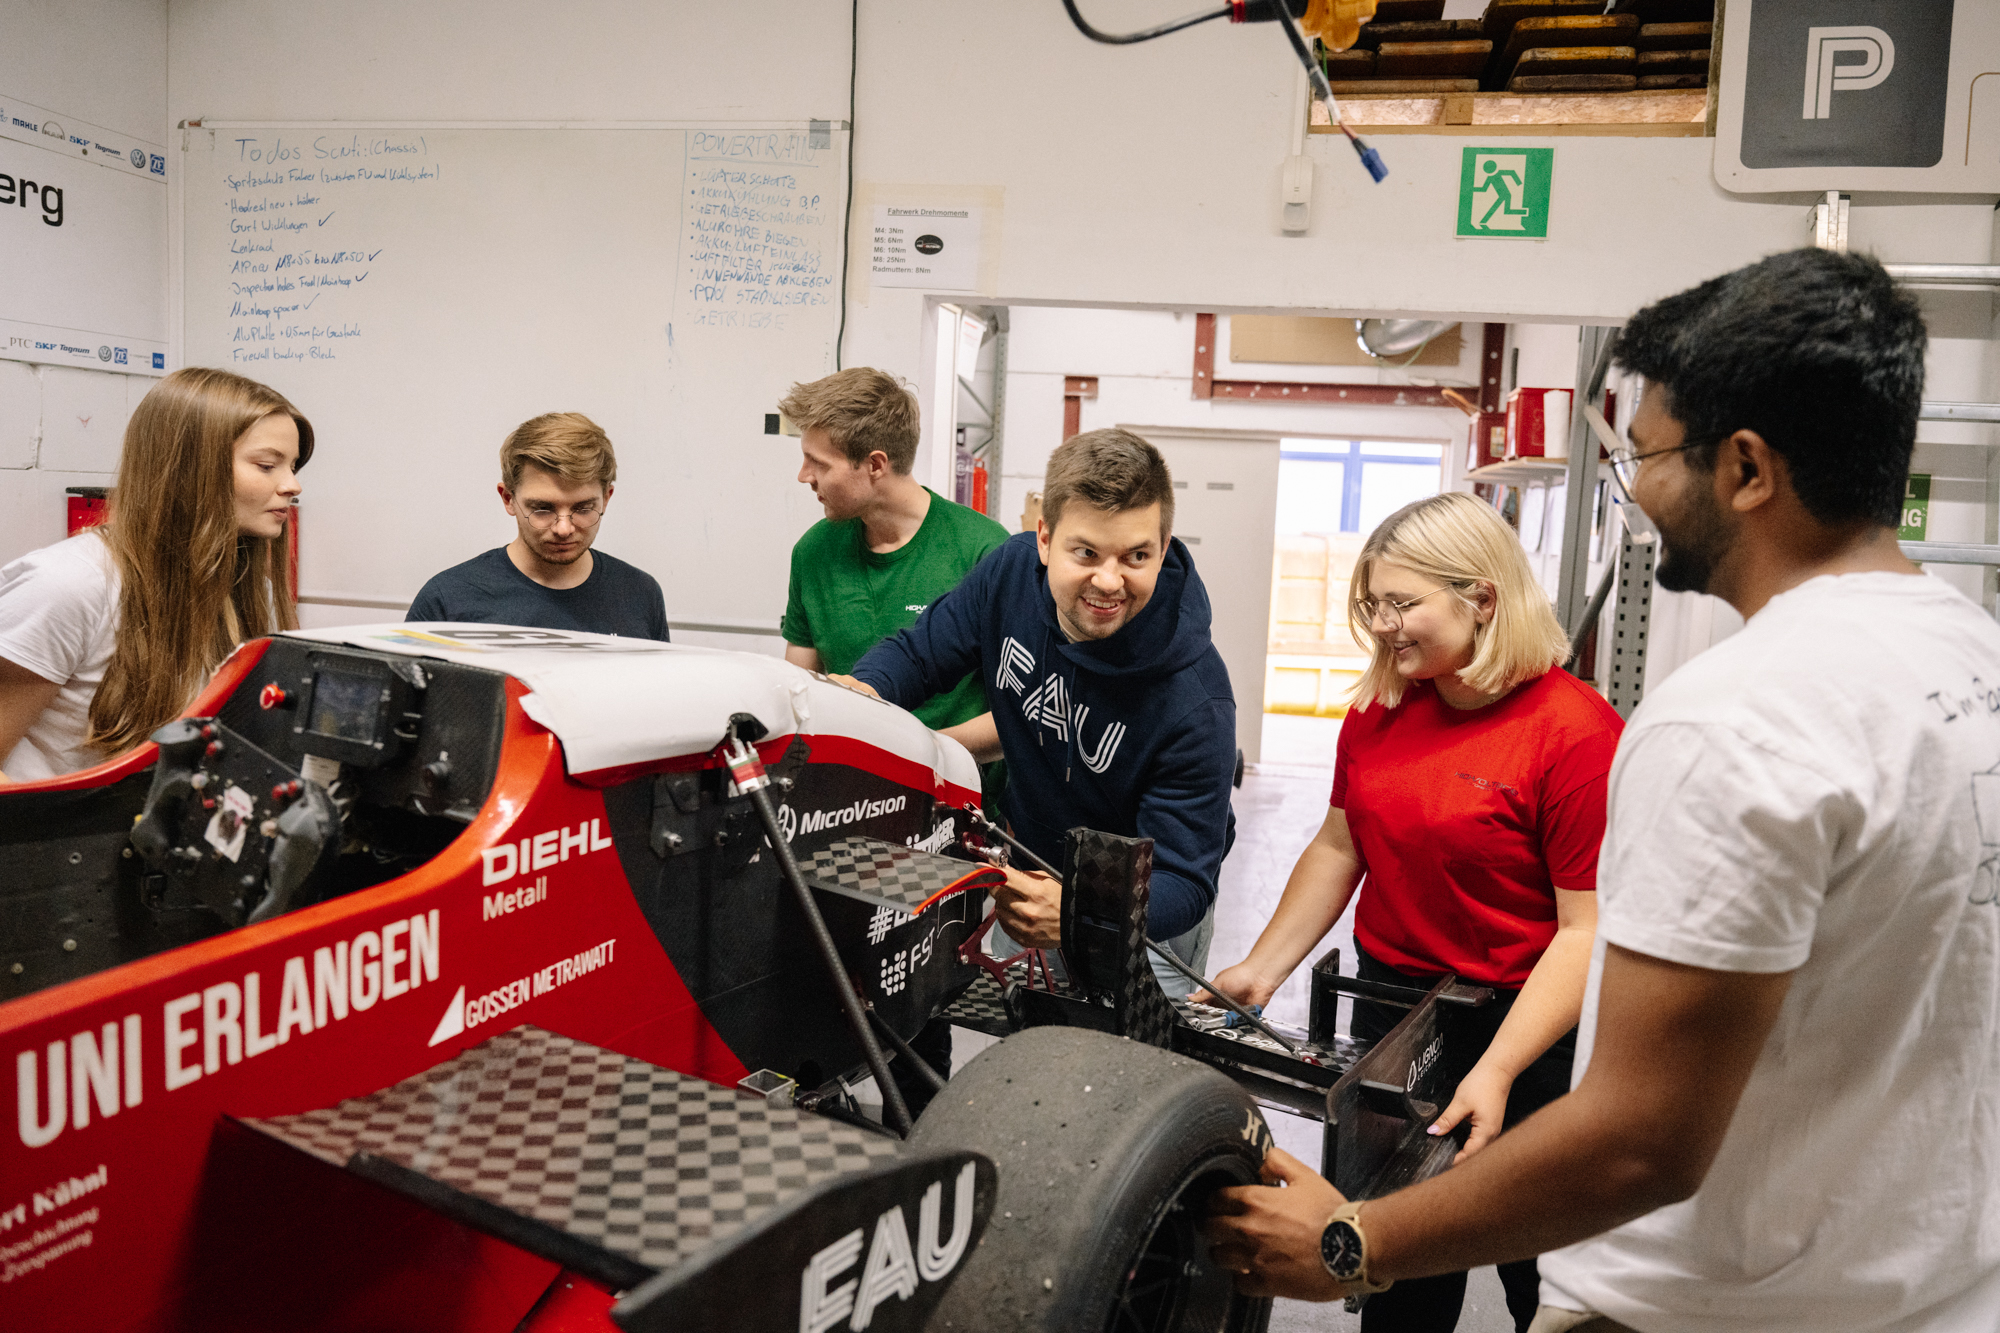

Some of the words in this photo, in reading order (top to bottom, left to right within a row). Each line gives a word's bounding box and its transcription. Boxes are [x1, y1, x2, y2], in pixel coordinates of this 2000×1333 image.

[1803, 26, 1895, 119] P
[12, 118, 38, 132] MAHLE
[69, 135, 90, 146] SKF
[0, 173, 63, 227] erg
[887, 207, 919, 216] Fahrwerk
[920, 208, 968, 218] Drehmomente
[872, 266, 914, 274] Radmuttern:
[10, 337, 31, 348] PTC
[35, 341, 57, 350] SKF
[996, 636, 1127, 774] FAU
[481, 818, 613, 887] DIEHL
[483, 875, 547, 922] Metall
[533, 938, 616, 998] METRAWATT
[163, 909, 440, 1091] ERLANGEN
[465, 976, 531, 1029] GOSSEN
[16, 1013, 143, 1149] UNI
[798, 1159, 977, 1333] FAU
